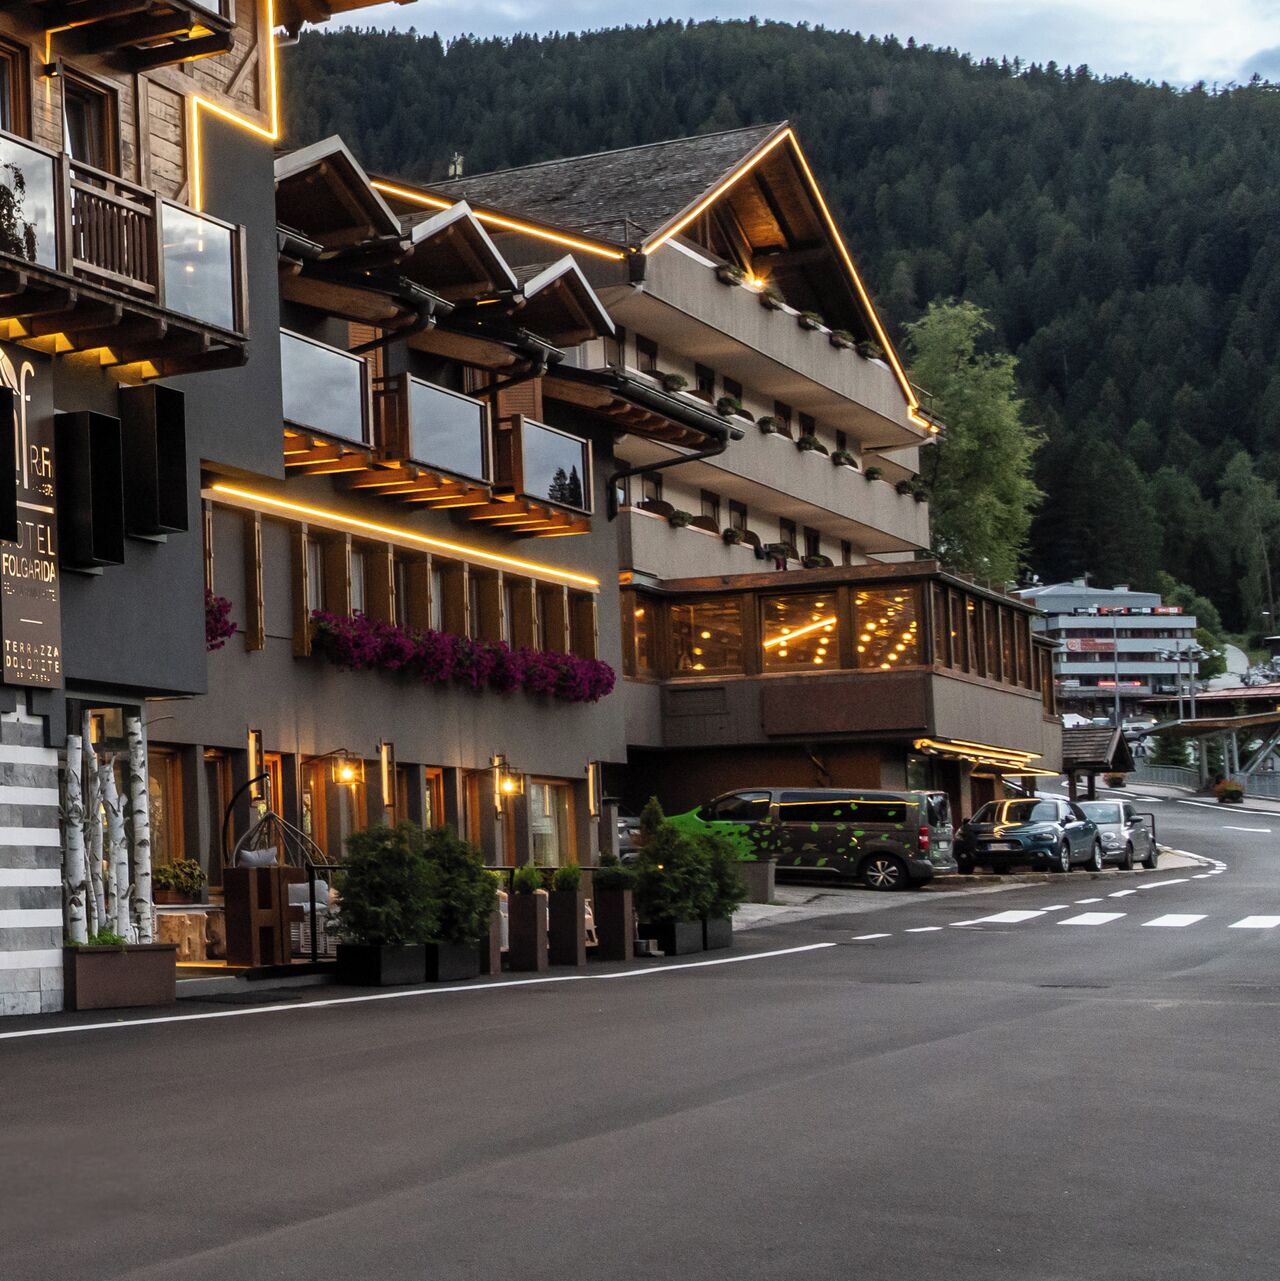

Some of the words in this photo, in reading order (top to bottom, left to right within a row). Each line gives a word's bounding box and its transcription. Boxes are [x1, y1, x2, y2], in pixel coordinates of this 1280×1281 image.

[1, 520, 56, 556] OTEL
[2, 553, 56, 583] FOLGARIDA
[5, 639, 60, 658] TERRAZZA
